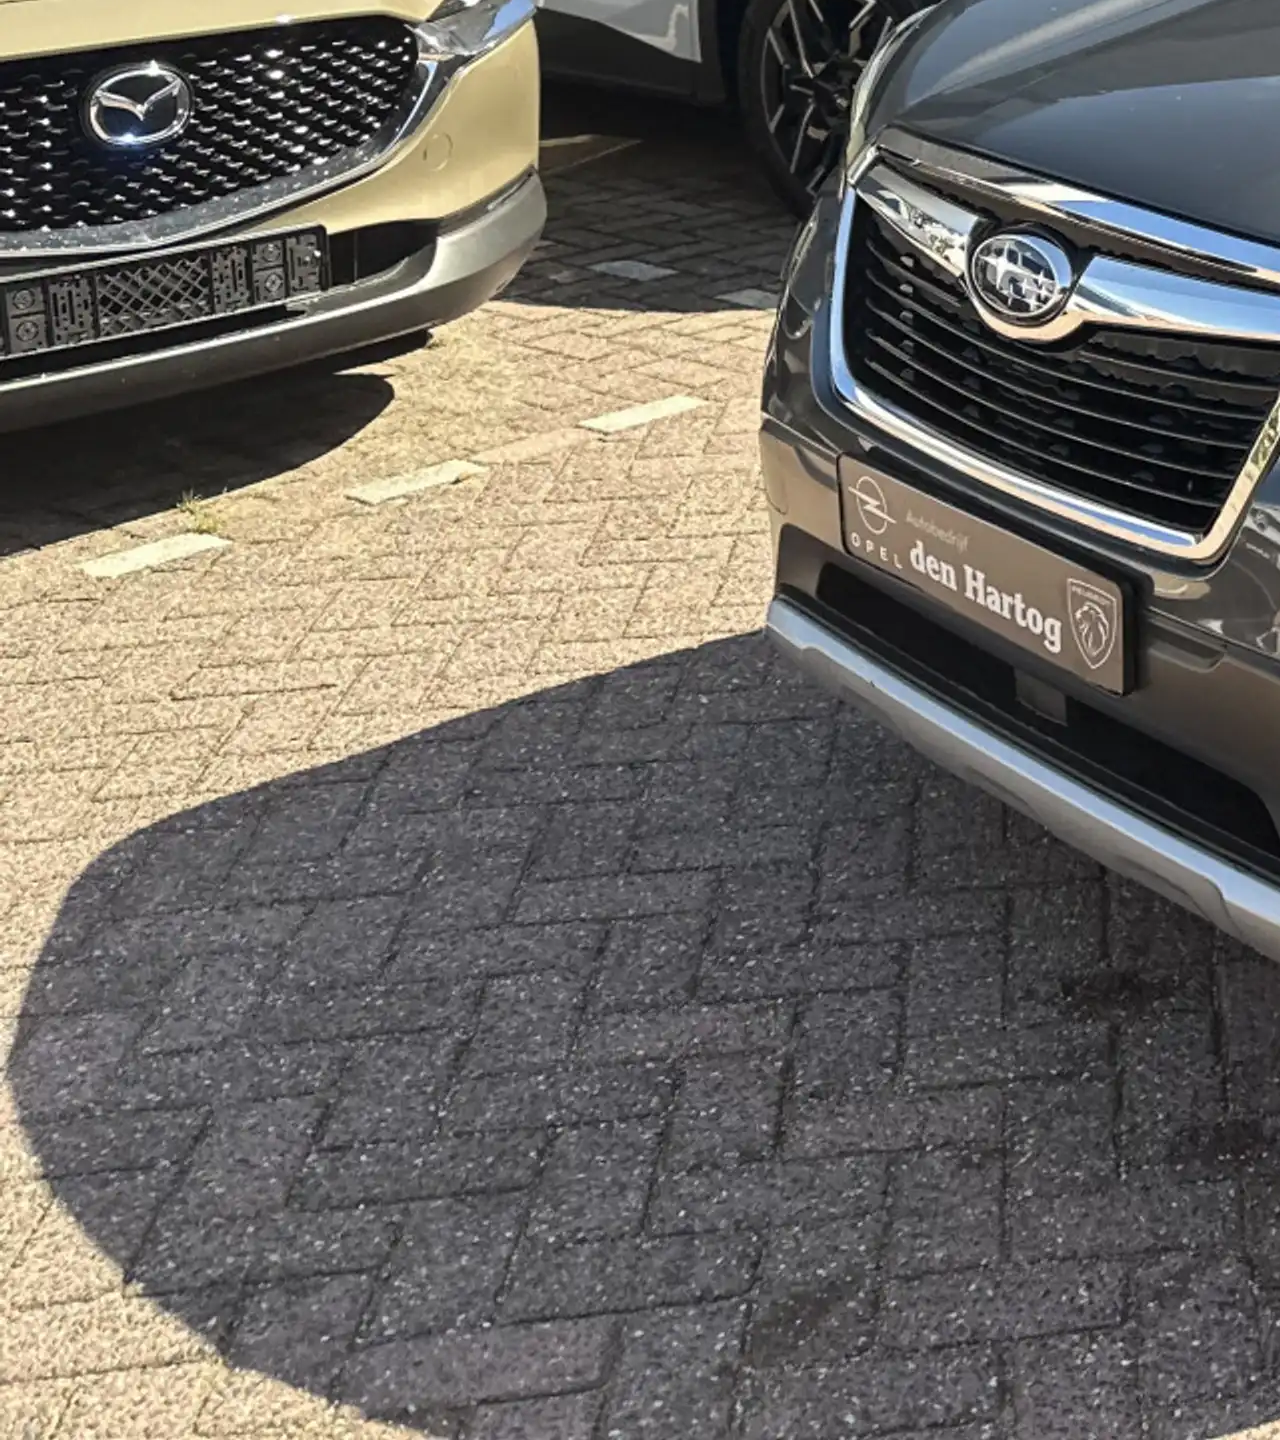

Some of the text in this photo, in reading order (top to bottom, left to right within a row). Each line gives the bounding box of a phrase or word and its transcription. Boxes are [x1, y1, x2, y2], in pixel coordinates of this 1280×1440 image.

[851, 532, 902, 569] OPEL
[910, 540, 1062, 653] den Hartog
